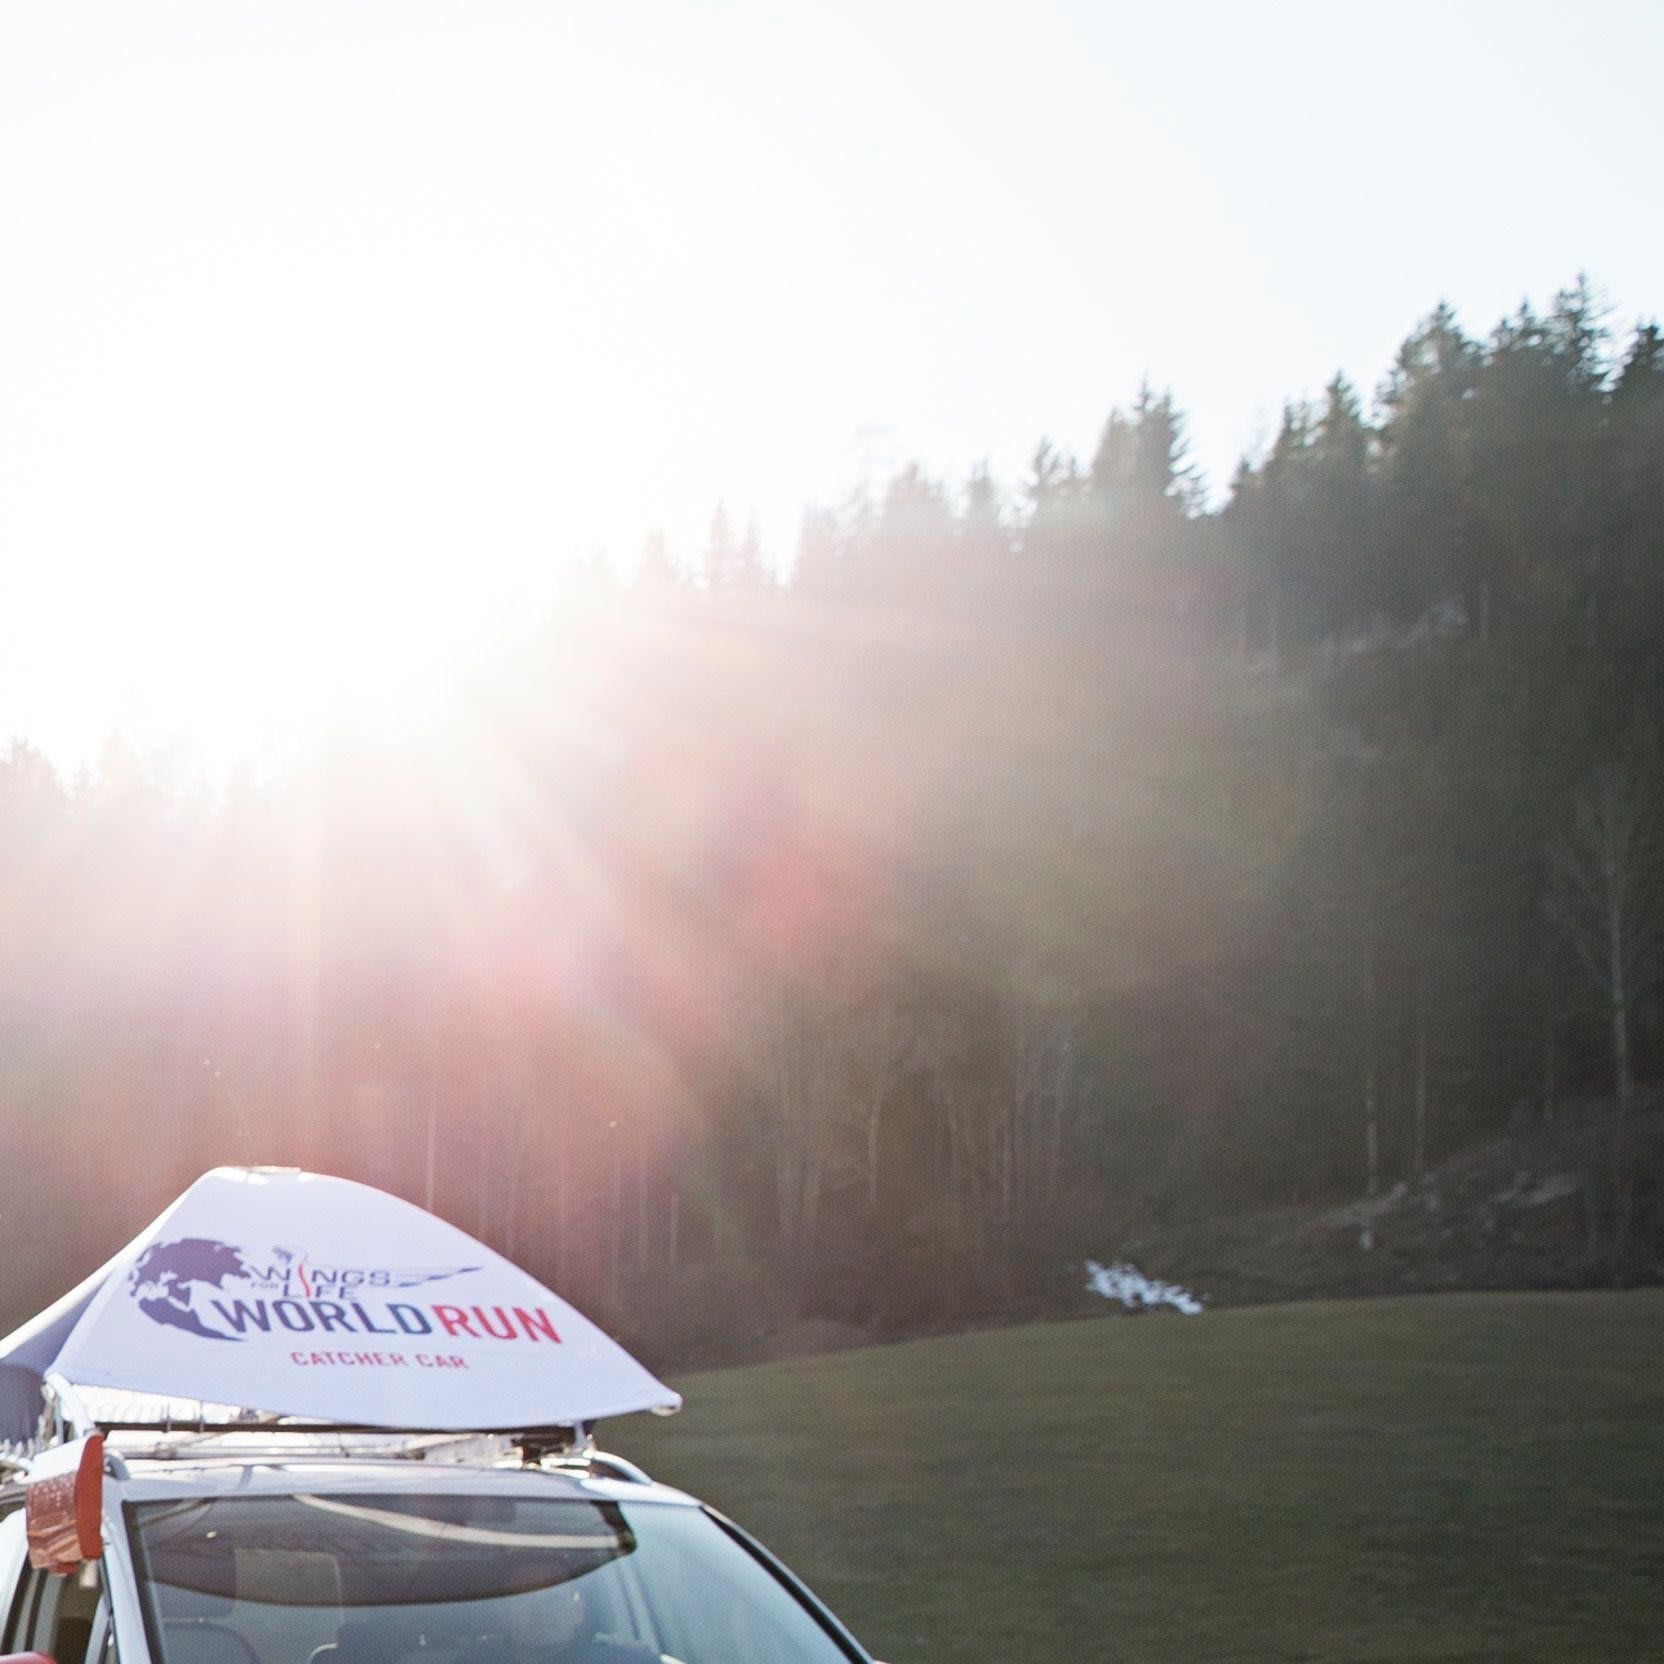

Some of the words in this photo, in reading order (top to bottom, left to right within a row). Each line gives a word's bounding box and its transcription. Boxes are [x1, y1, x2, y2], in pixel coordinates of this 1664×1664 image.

[250, 1265, 390, 1286] WINGS
[283, 1284, 356, 1300] LIFE
[290, 1350, 409, 1368] CATCHER
[415, 1352, 469, 1369] CAR
